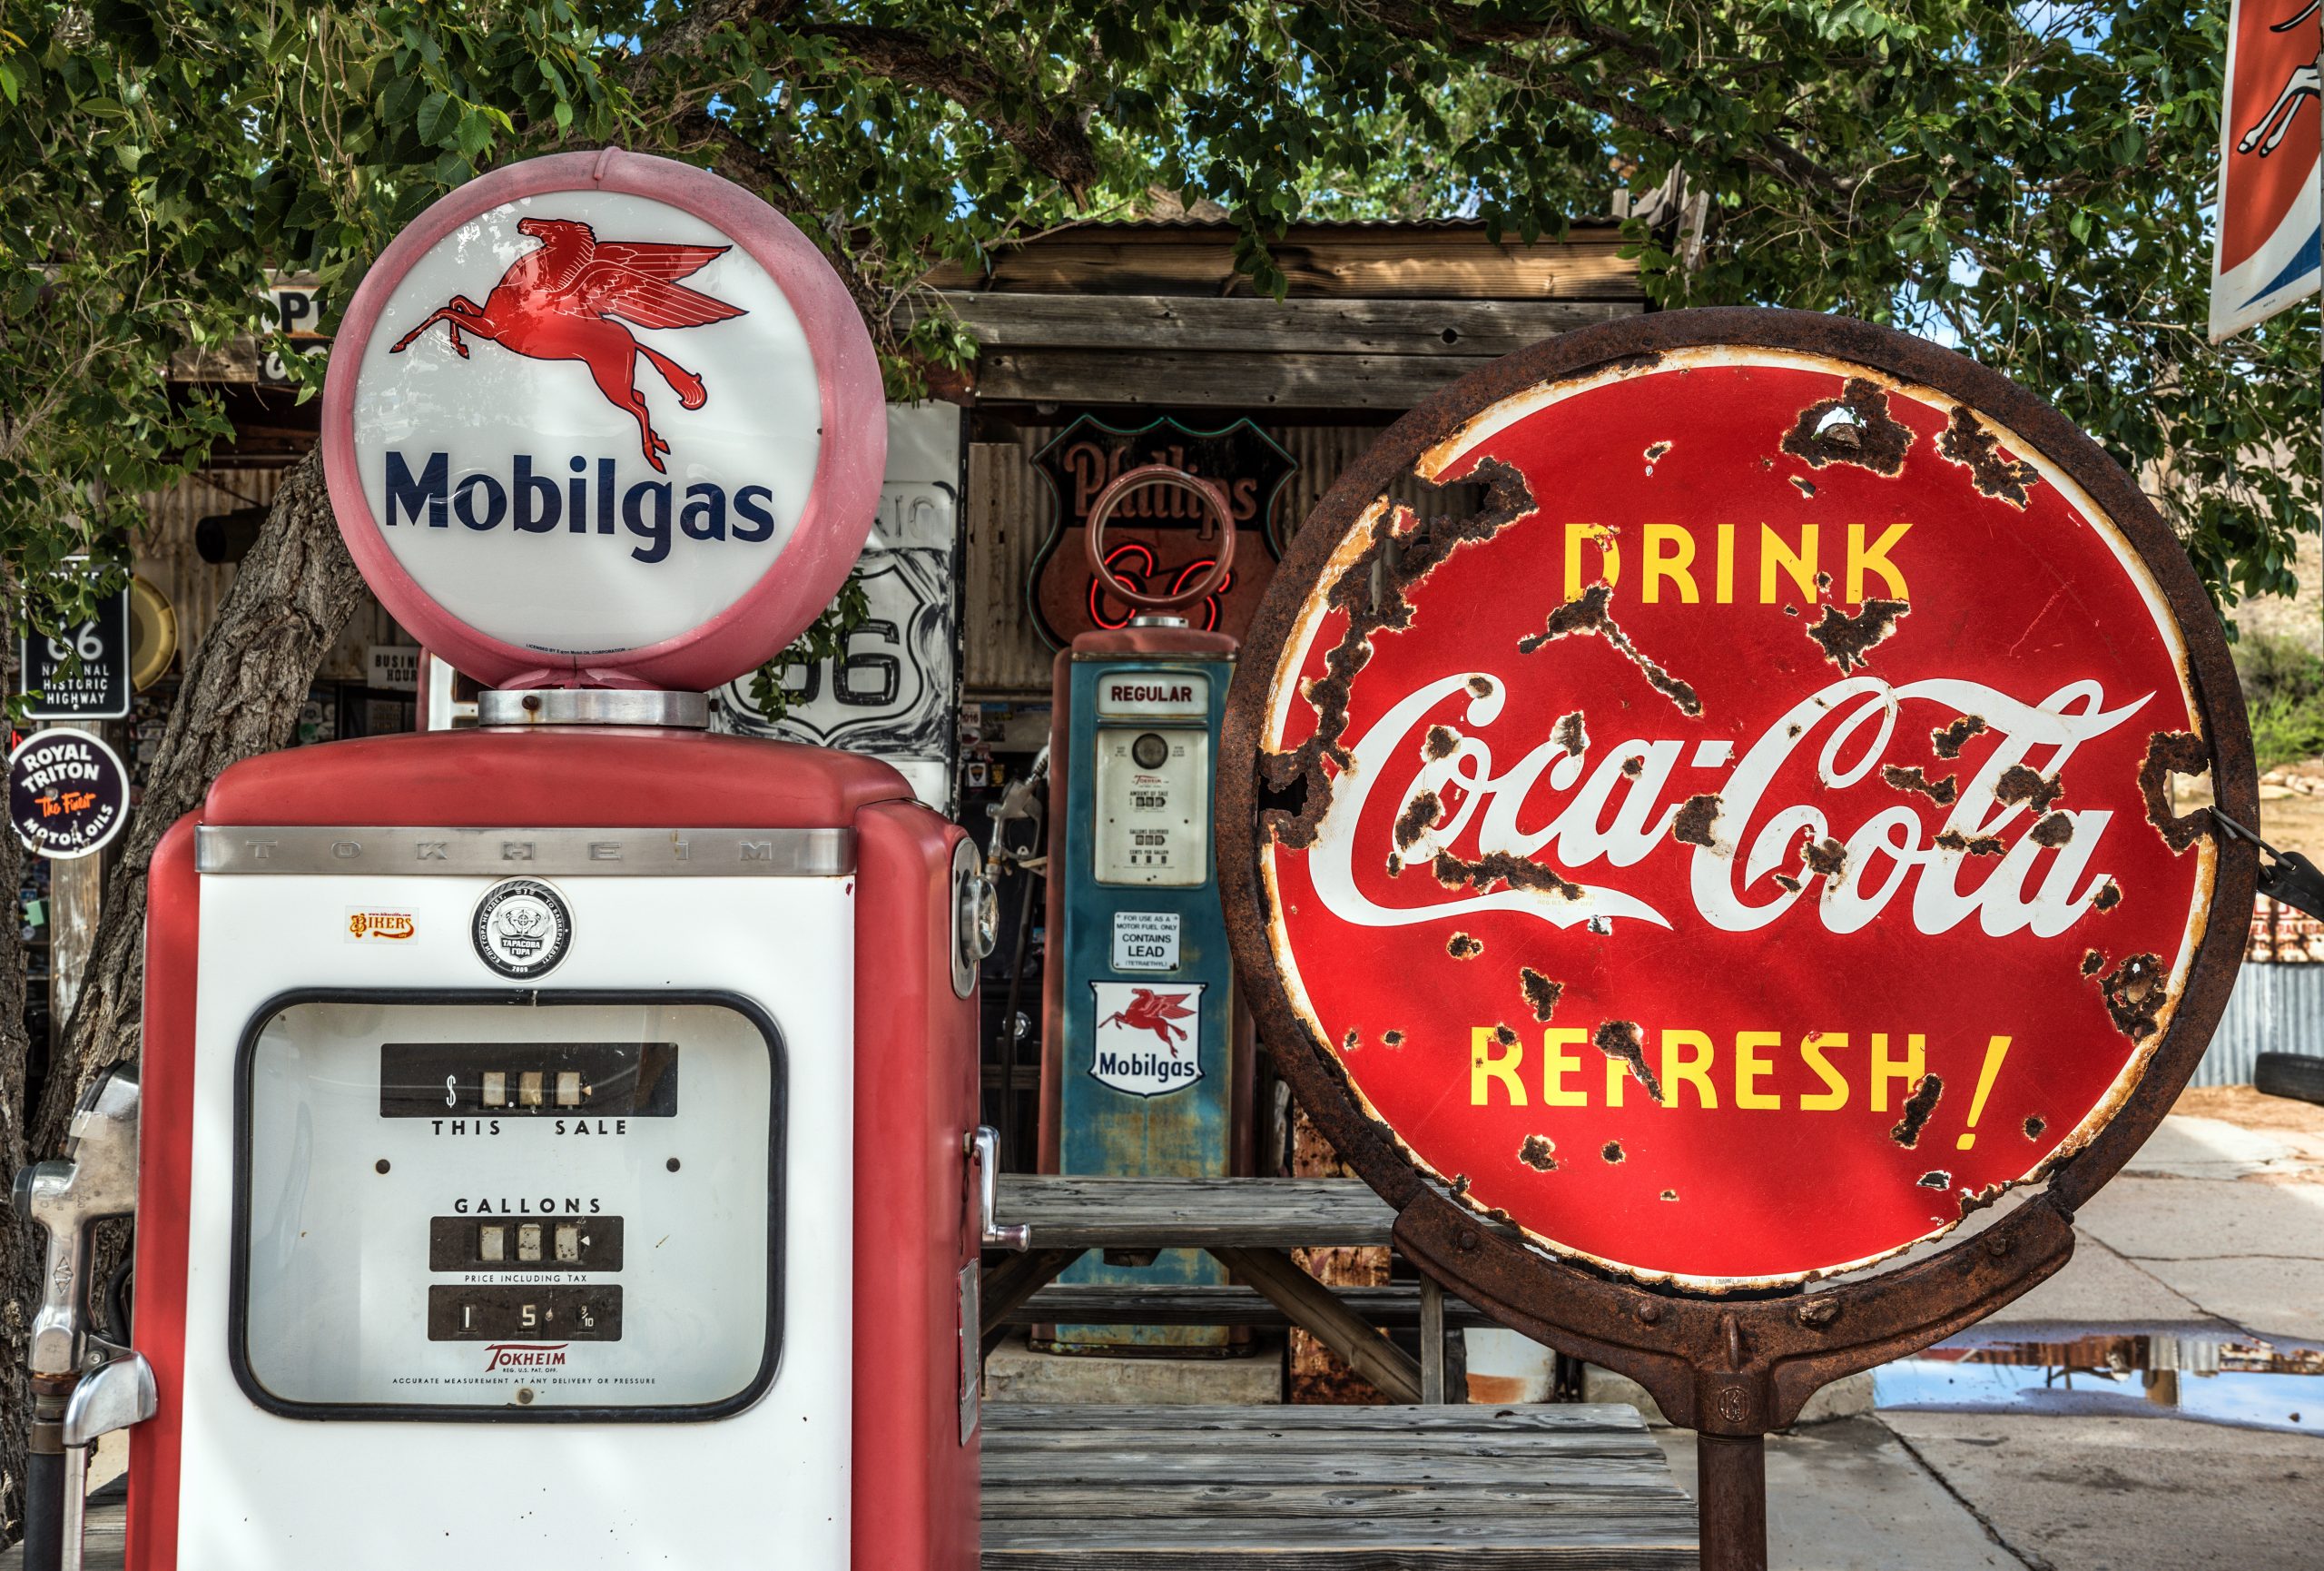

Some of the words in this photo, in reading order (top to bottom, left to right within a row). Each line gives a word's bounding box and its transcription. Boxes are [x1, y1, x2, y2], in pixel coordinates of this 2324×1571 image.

[1063, 440, 1258, 540] Phillips
[385, 450, 775, 564] Mobilgas
[1563, 521, 1914, 605] DRINK
[47, 618, 103, 661] 66
[42, 664, 110, 677] NANAL
[375, 655, 419, 668] BUSIN
[44, 678, 107, 690] HISTORIC
[1111, 686, 1192, 702] REGULAR
[47, 692, 105, 705] HIGHWAY
[21, 744, 93, 772] ROYAL
[20, 762, 101, 794] TRITON
[34, 795, 61, 817] The
[61, 792, 96, 815] Finest
[1308, 671, 2157, 938] Coca-Cola
[23, 817, 83, 845] MOTOR
[85, 804, 113, 836] OILS
[246, 839, 772, 861] TOKHEIM
[546, 899, 554, 908] ТО
[350, 913, 414, 938] BIKERS
[482, 914, 488, 923] НЕ
[502, 939, 541, 949] ТАРАСОВА
[1122, 934, 1171, 943] CONTAINS
[484, 945, 501, 963] ЕСЛИ
[511, 947, 530, 955] ГОРА
[1128, 945, 1165, 957] LEAD
[1099, 1052, 1195, 1082] Mobilgas
[446, 1075, 457, 1108] $
[431, 1120, 500, 1135] THIS
[555, 1120, 626, 1135] SALE
[454, 1198, 601, 1213] GALLONS
[465, 1274, 494, 1282] PRICE
[500, 1274, 561, 1282] INCLUDING
[567, 1274, 587, 1282] TAX
[522, 1304, 536, 1327] 5
[484, 1343, 569, 1373] TOKHEIM
